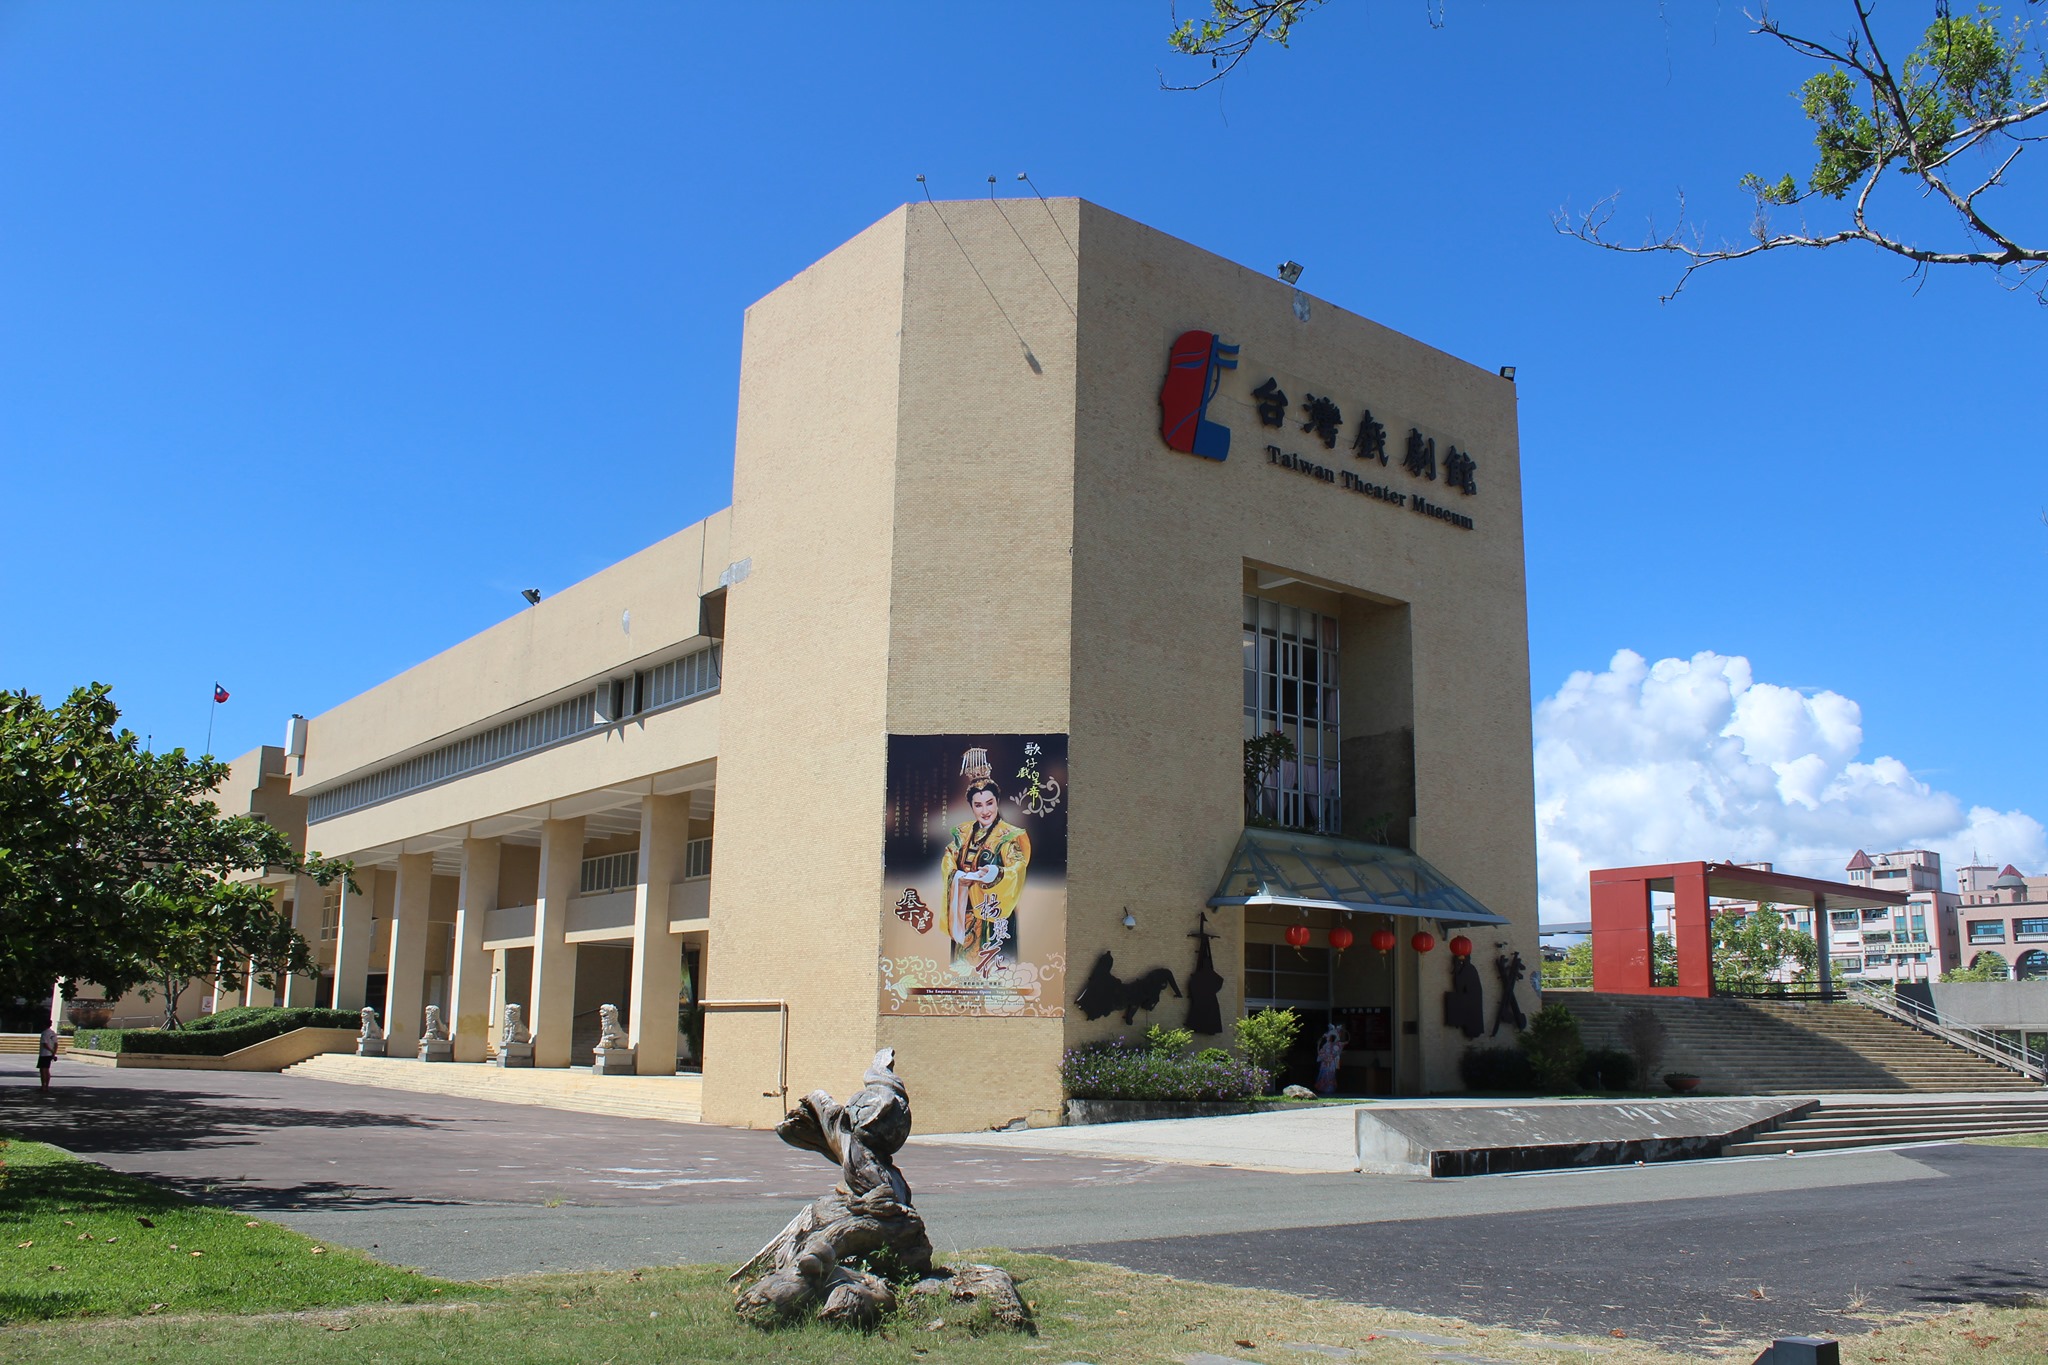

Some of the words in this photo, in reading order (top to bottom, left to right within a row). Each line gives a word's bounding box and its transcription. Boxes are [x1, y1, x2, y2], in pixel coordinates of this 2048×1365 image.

[1267, 444, 1335, 484] Taiwan
[1341, 470, 1406, 508] Theater
[1412, 494, 1474, 530] Museum
[974, 892, 1011, 979] 楊麗花
